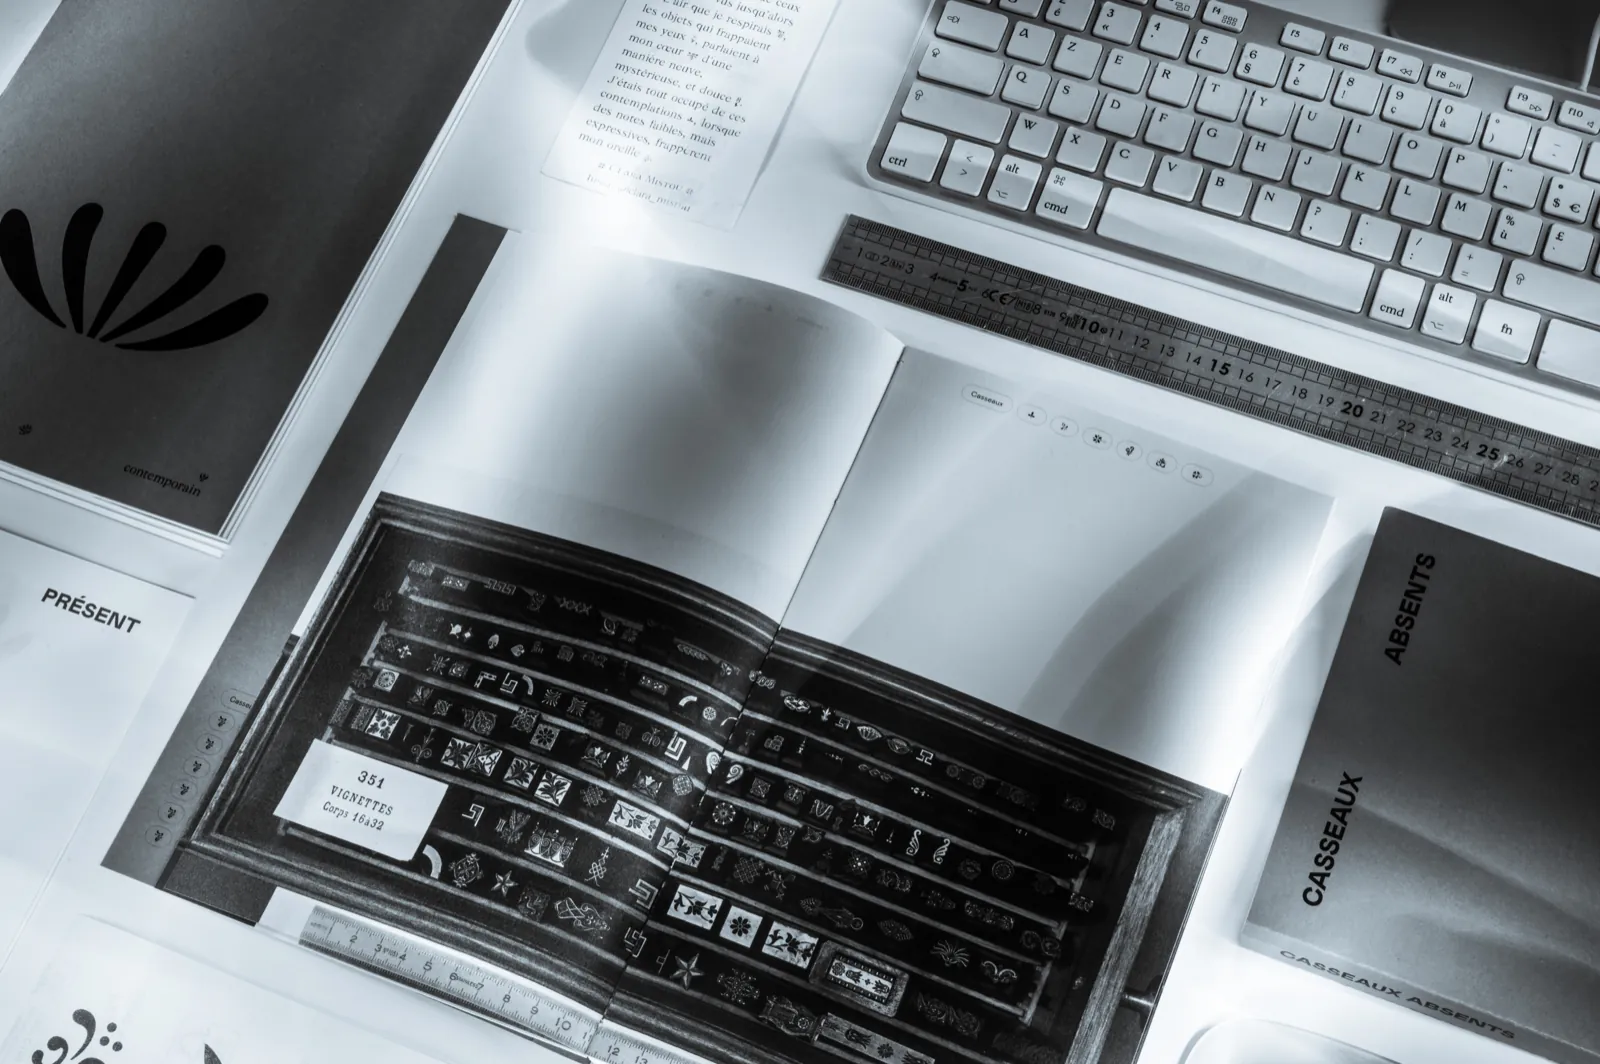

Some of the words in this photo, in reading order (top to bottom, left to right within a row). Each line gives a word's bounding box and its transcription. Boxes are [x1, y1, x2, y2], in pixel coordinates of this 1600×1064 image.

[736, 3, 795, 27] jusqu'alors
[1106, 9, 1115, 19] 3
[1211, 6, 1222, 16] f4
[690, 4, 711, 17] que
[712, 7, 723, 21] je
[726, 15, 772, 36] respirais
[642, 4, 658, 16] les
[661, 9, 693, 28] objets
[696, 21, 714, 35] qui
[716, 27, 772, 52] frappaient
[1154, 22, 1162, 32] 4
[1019, 28, 1030, 40] A
[1290, 29, 1301, 39] f5
[636, 20, 658, 33] mes
[660, 28, 686, 41] yeux
[702, 40, 751, 61] parlaient
[753, 54, 760, 65] à
[1067, 41, 1078, 52] Z
[1200, 36, 1210, 46] 5
[1338, 42, 1349, 52] f6
[622, 48, 666, 67] manière
[629, 34, 653, 47] mon
[656, 43, 685, 57] cœur
[702, 55, 734, 72] d'une
[1249, 50, 1259, 60] 6
[1114, 55, 1126, 66] E
[1386, 56, 1398, 66] f7
[1161, 68, 1173, 80] R
[1297, 63, 1306, 73] 7
[1016, 71, 1028, 84] Q
[1293, 75, 1300, 86] è
[1435, 69, 1448, 80] f8
[1211, 82, 1222, 93] T
[1346, 77, 1355, 87] 8
[686, 82, 697, 92] et
[699, 86, 733, 104] douce
[1062, 85, 1071, 96] S
[1395, 91, 1404, 101] 9
[607, 75, 643, 94] J'étais
[646, 87, 667, 101] tout
[671, 94, 710, 113] occupé
[712, 106, 727, 117] de
[728, 112, 747, 124] ces
[1259, 96, 1270, 108] Y
[1518, 92, 1529, 102] f9
[1110, 99, 1122, 111] D
[600, 89, 683, 122] contemplations
[701, 117, 743, 139] lorsque
[1158, 112, 1170, 124] F
[1307, 111, 1319, 122] U
[1568, 107, 1584, 118] f10
[592, 104, 613, 117] des
[616, 112, 645, 127] notes
[649, 118, 687, 140] faibles,
[690, 131, 717, 148] mais
[1023, 119, 1038, 131] W
[1356, 125, 1363, 135] I
[1206, 127, 1219, 139] G
[579, 132, 604, 147] mon
[606, 143, 641, 158] oreille
[586, 118, 651, 147] expressives,
[655, 137, 713, 164] frappèrent
[1070, 134, 1081, 145] X
[1407, 139, 1419, 151] O
[1255, 141, 1267, 153] H
[1119, 149, 1131, 160] C
[1456, 154, 1467, 164] P
[888, 156, 909, 169] ctrl
[1303, 156, 1314, 166] J
[1005, 163, 1020, 175] alt
[1167, 162, 1179, 173] V
[1215, 176, 1226, 188] B
[1354, 171, 1365, 183] K
[1264, 191, 1277, 203] N
[1404, 185, 1412, 197] L
[1044, 200, 1069, 216] cmd
[1454, 201, 1467, 213] M
[1438, 292, 1454, 304] alt
[1380, 303, 1406, 319] cmd
[1500, 323, 1514, 336] fn
[880, 255, 890, 267] 2
[905, 263, 915, 275] 3
[929, 272, 939, 283] 4
[957, 279, 969, 292] 5
[1032, 304, 1042, 316] 8
[1080, 317, 1100, 334] 10
[1109, 329, 1124, 341] 11
[1134, 335, 1150, 350] 12
[1160, 344, 1176, 358] 13
[1186, 352, 1202, 366] 14
[1210, 359, 1232, 376] 15
[1239, 369, 1254, 383] 16
[1265, 377, 1282, 391] 17
[1291, 385, 1309, 400] 18
[1318, 394, 1335, 408] 19
[1340, 401, 1364, 418] 20
[1370, 411, 1386, 425] 21
[1397, 420, 1416, 434] 22
[1424, 428, 1443, 443] 23
[1451, 436, 1470, 451] 24
[1476, 444, 1501, 461] 25
[1506, 454, 1525, 469] 26
[1534, 462, 1553, 476] 27
[1562, 471, 1581, 486] 28
[971, 391, 1004, 408] Casseaux
[124, 463, 202, 498] contemporain
[41, 588, 142, 634] PRÉSENT
[230, 696, 252, 709] Casse
[1301, 771, 1364, 908] CASSEAUX
[1384, 553, 1436, 666] ABSENTS
[358, 770, 386, 790] 351
[331, 786, 394, 816] VIGNETTES
[323, 802, 349, 819] Corps
[423, 962, 433, 972] 5
[503, 994, 511, 1003] 8
[530, 1006, 539, 1015] 9
[555, 1017, 572, 1031] 10
[1280, 950, 1403, 998] CASSEAUX
[1406, 996, 1516, 1040] ABSENTS
[608, 1045, 621, 1056] 12
